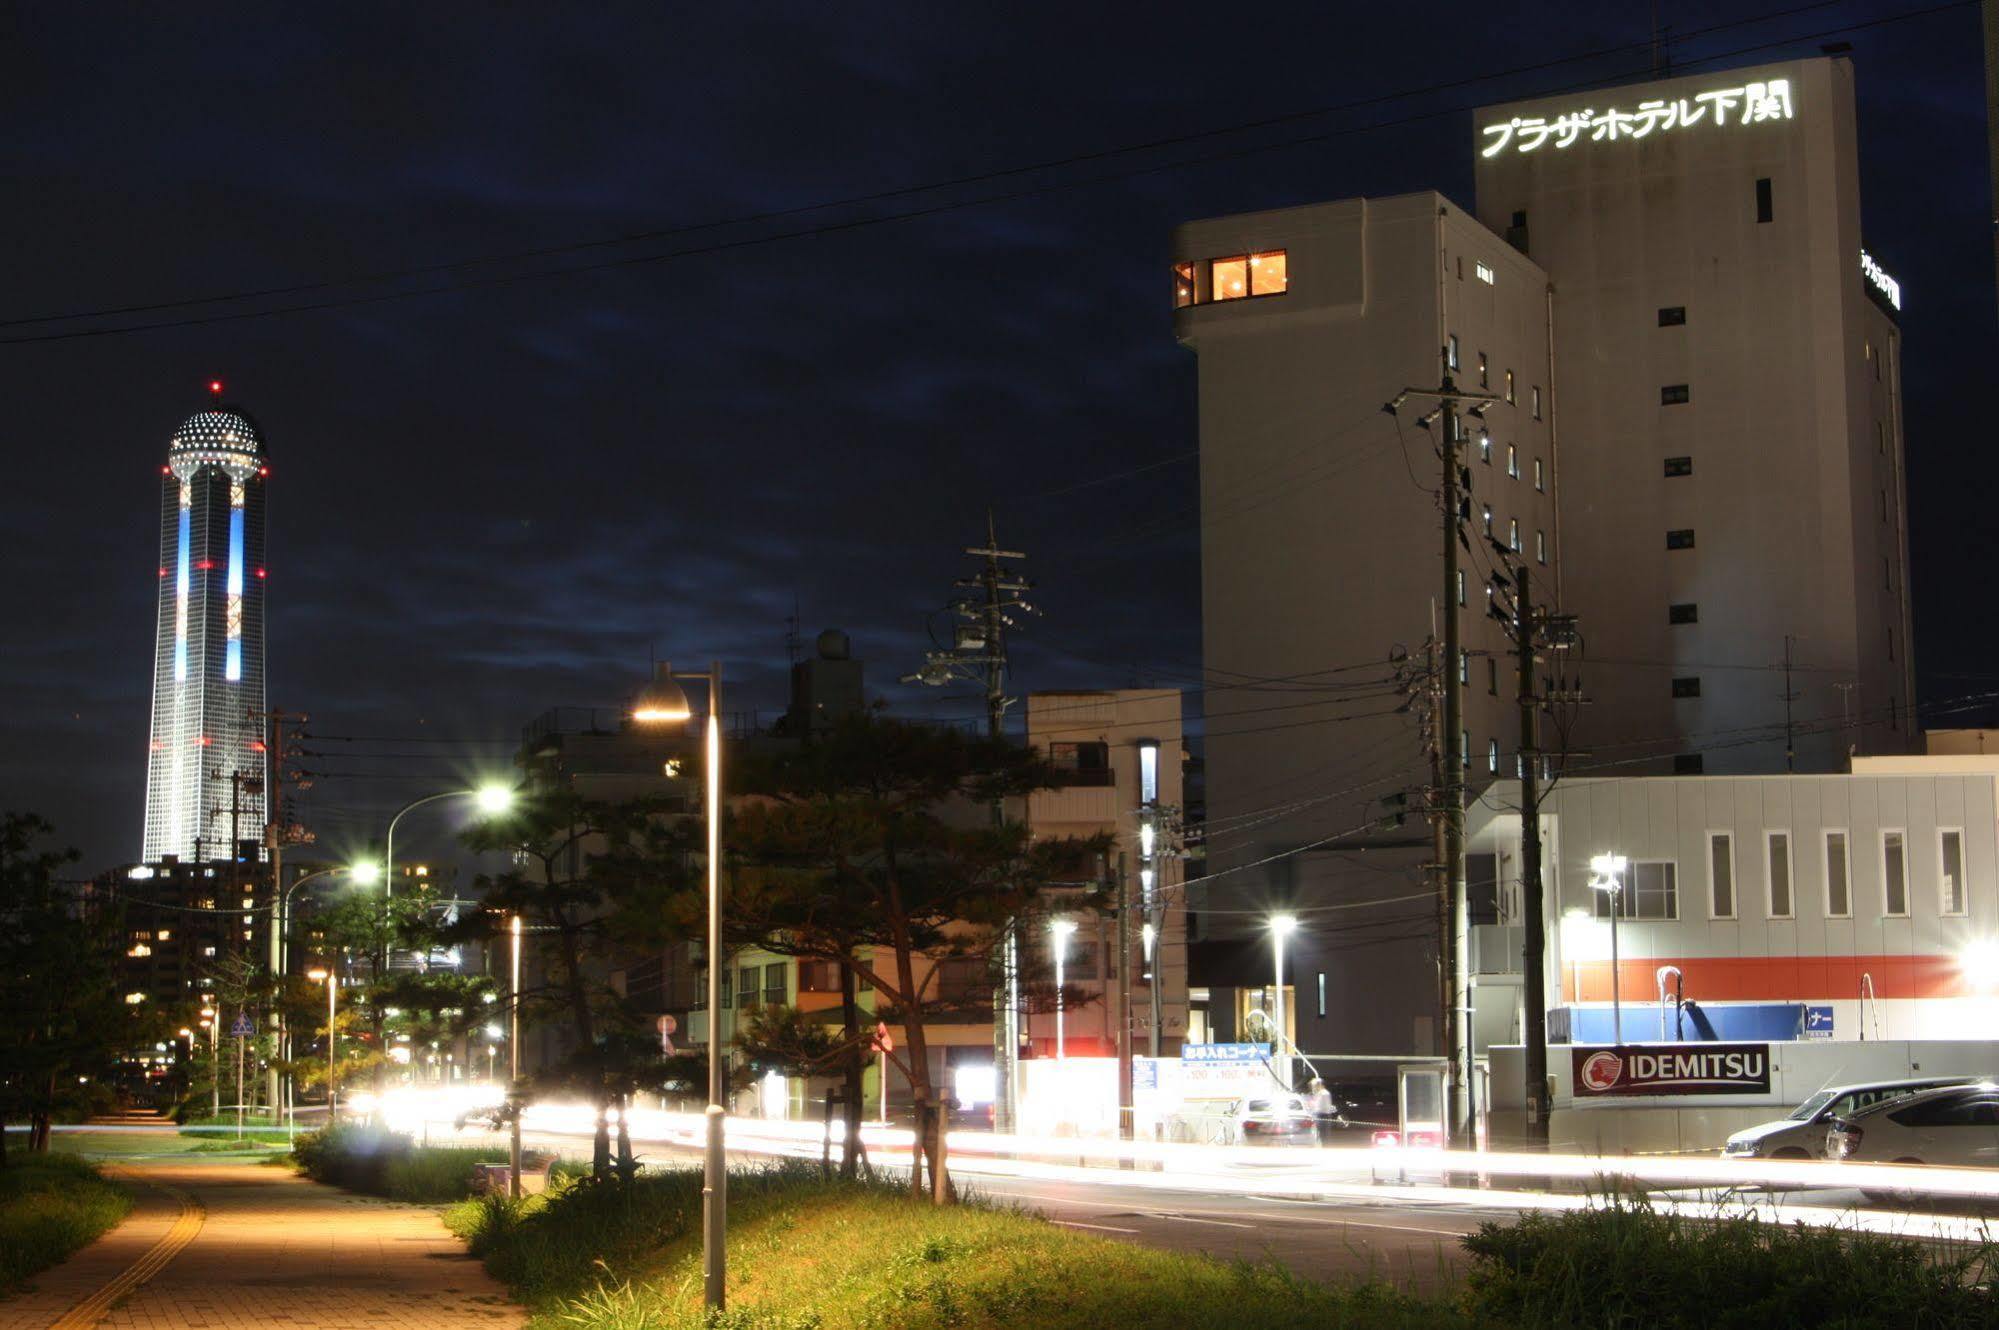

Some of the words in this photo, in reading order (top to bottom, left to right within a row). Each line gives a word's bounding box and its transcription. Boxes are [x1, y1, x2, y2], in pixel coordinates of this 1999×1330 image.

[1482, 79, 1793, 157] プラザホテル下関
[1629, 1053, 1763, 1079] IDEMITSU
